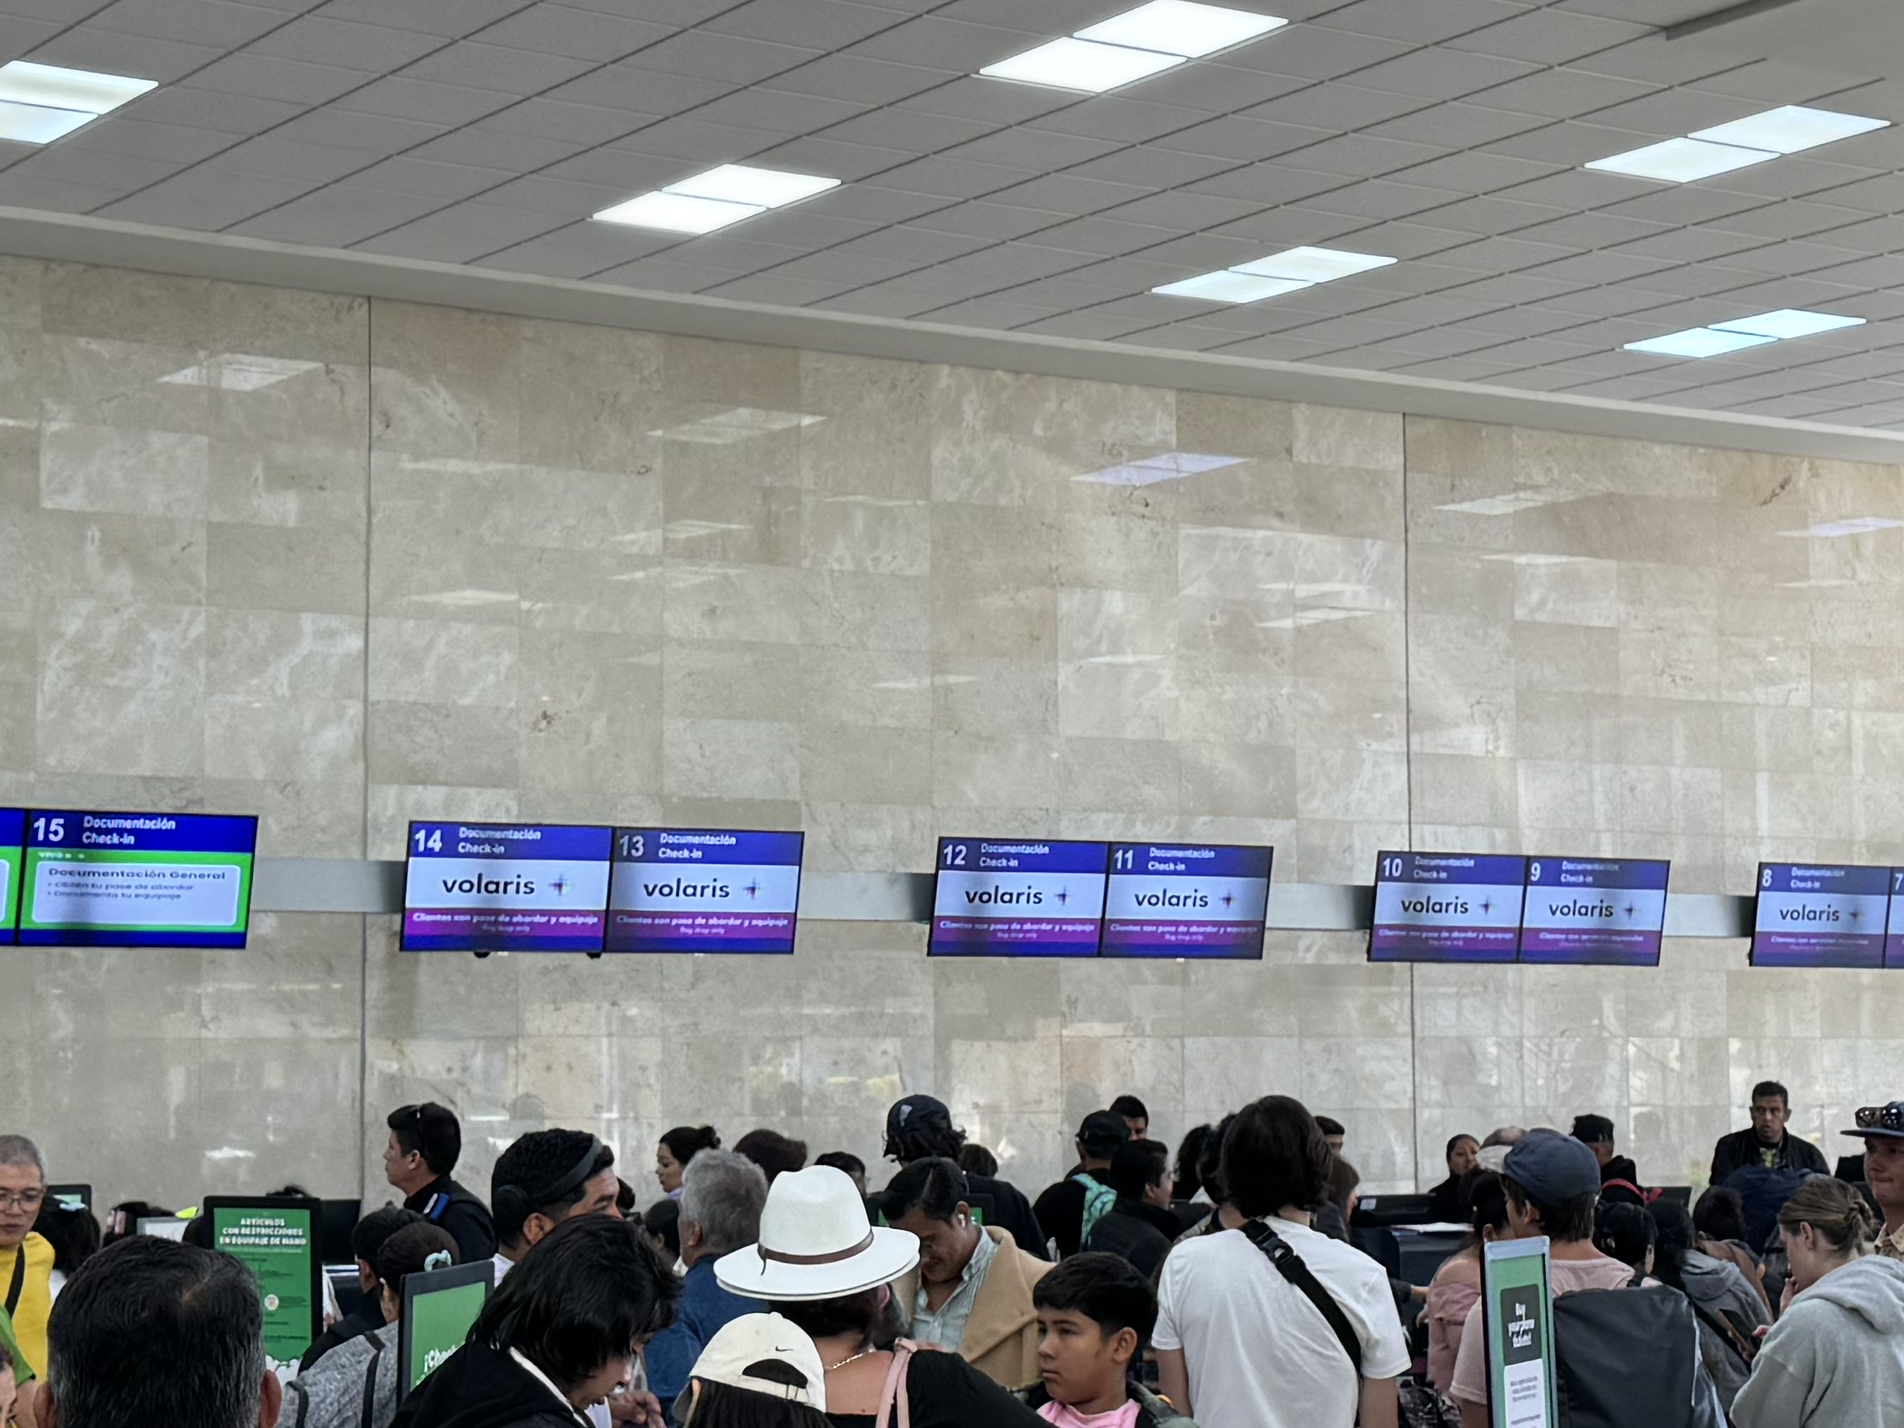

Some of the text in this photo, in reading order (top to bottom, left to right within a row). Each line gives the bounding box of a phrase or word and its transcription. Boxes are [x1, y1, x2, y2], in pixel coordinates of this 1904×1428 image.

[33, 817, 65, 842] 15
[83, 815, 176, 830] Documentación
[82, 831, 135, 845] Check-in
[414, 829, 443, 853] 14
[459, 827, 541, 840] Documentación
[660, 833, 736, 845] Documentación
[458, 842, 505, 854] Check-in
[619, 835, 645, 857] 13
[658, 847, 703, 859] Check-in
[943, 844, 967, 865] 12
[981, 843, 1049, 855] Documentación
[1114, 850, 1134, 869] 11
[1382, 858, 1403, 878] 10
[48, 868, 226, 880] Documentación General
[1530, 862, 1541, 881] 9
[1761, 868, 1772, 887] 8
[442, 873, 535, 895] volaris
[643, 877, 730, 898] volaris
[1895, 873, 1904, 891] 7
[965, 885, 1043, 904] volaris
[1134, 888, 1209, 908] volaris
[1400, 896, 1469, 914] volaris
[1548, 899, 1614, 918] volaris
[1779, 904, 1840, 922] volaris
